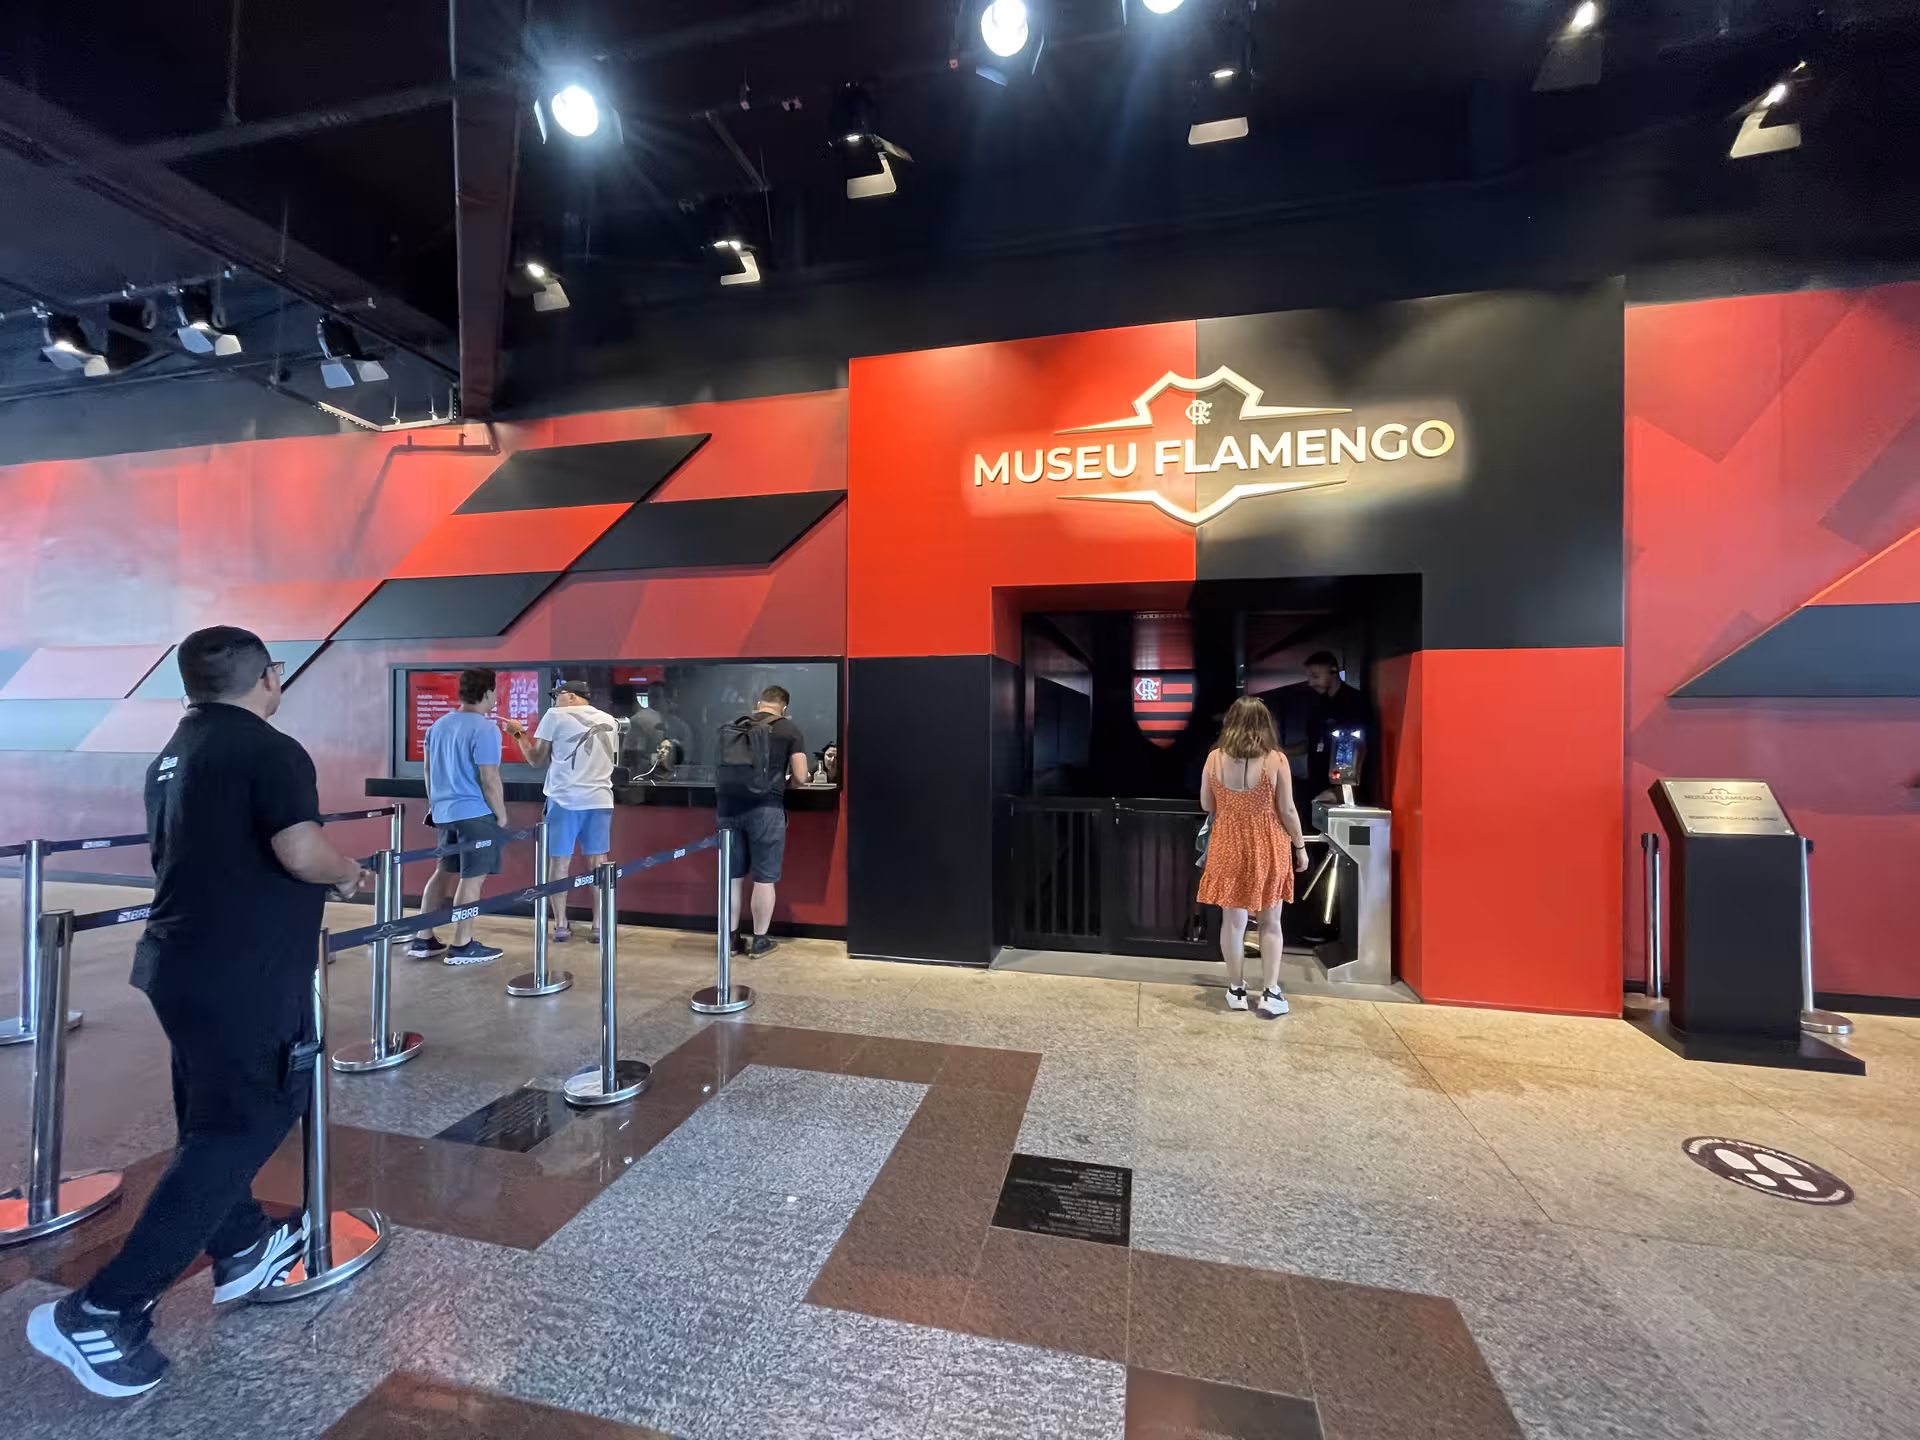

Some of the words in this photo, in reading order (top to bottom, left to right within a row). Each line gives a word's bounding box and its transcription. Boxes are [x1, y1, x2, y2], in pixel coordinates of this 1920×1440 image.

[974, 441, 1138, 487] MUSEU
[1154, 419, 1456, 476] FLAMENGO
[461, 906, 479, 920] BRB
